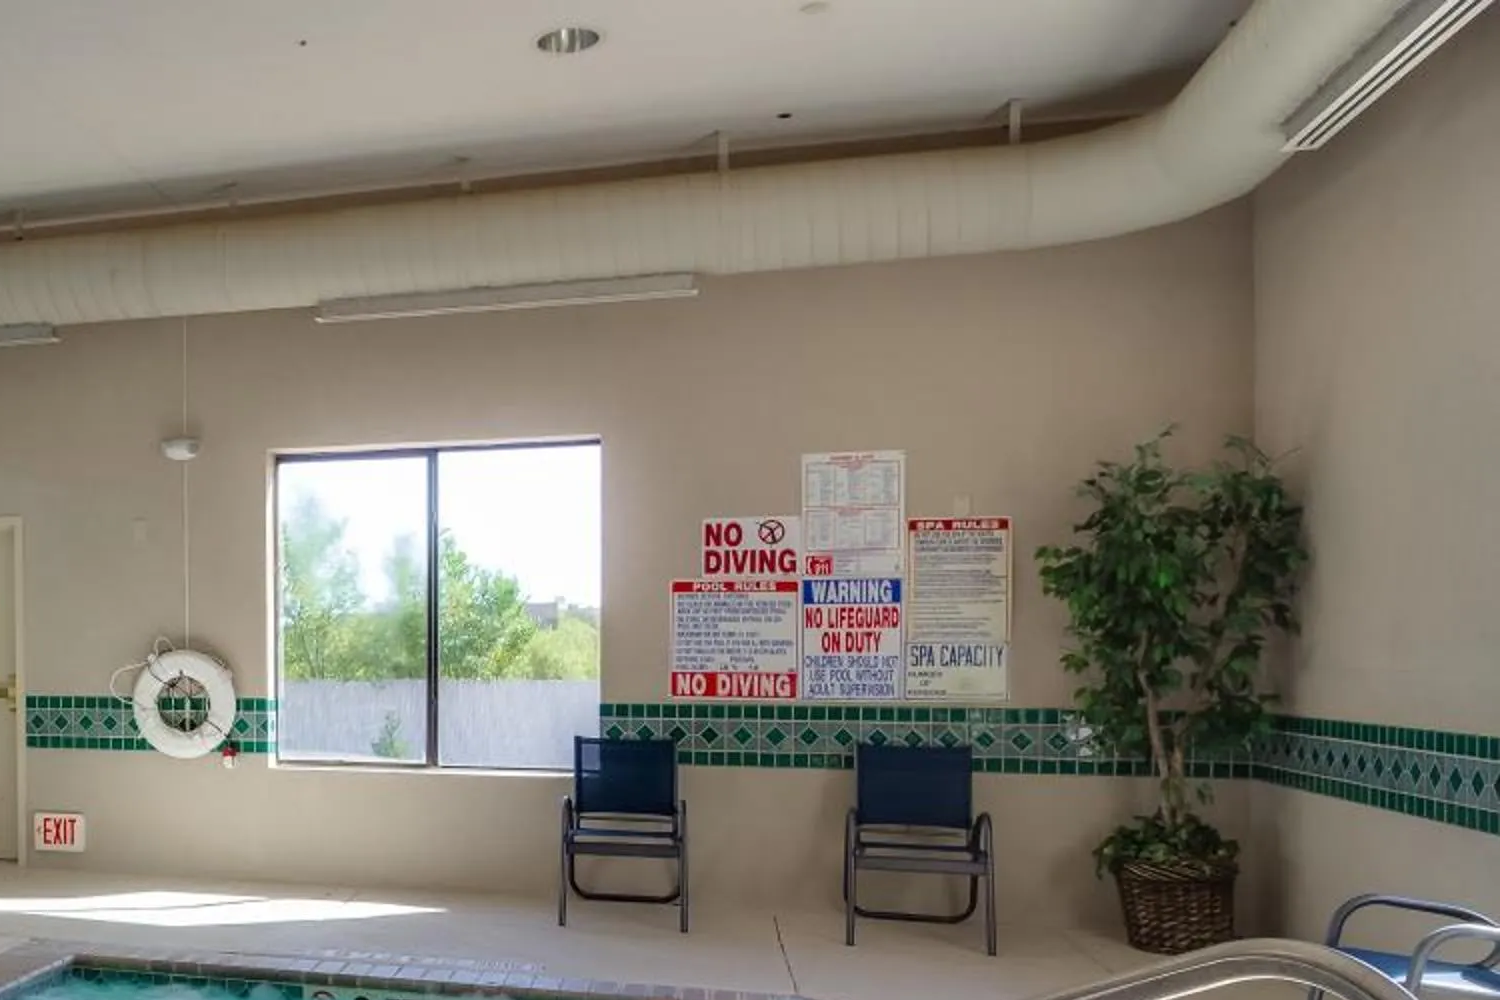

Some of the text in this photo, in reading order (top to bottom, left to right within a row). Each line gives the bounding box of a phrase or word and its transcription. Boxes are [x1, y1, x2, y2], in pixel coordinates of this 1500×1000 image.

[704, 522, 743, 547] NO
[704, 548, 797, 574] DIVING
[811, 579, 893, 603] WARNING
[805, 607, 823, 629] NO
[827, 606, 899, 629] LIFEGUARD
[821, 631, 882, 653] ON DUTY
[910, 645, 1004, 667] SPA CAPACITY
[676, 673, 792, 698] NO DIVING
[43, 817, 76, 845] EXIT
